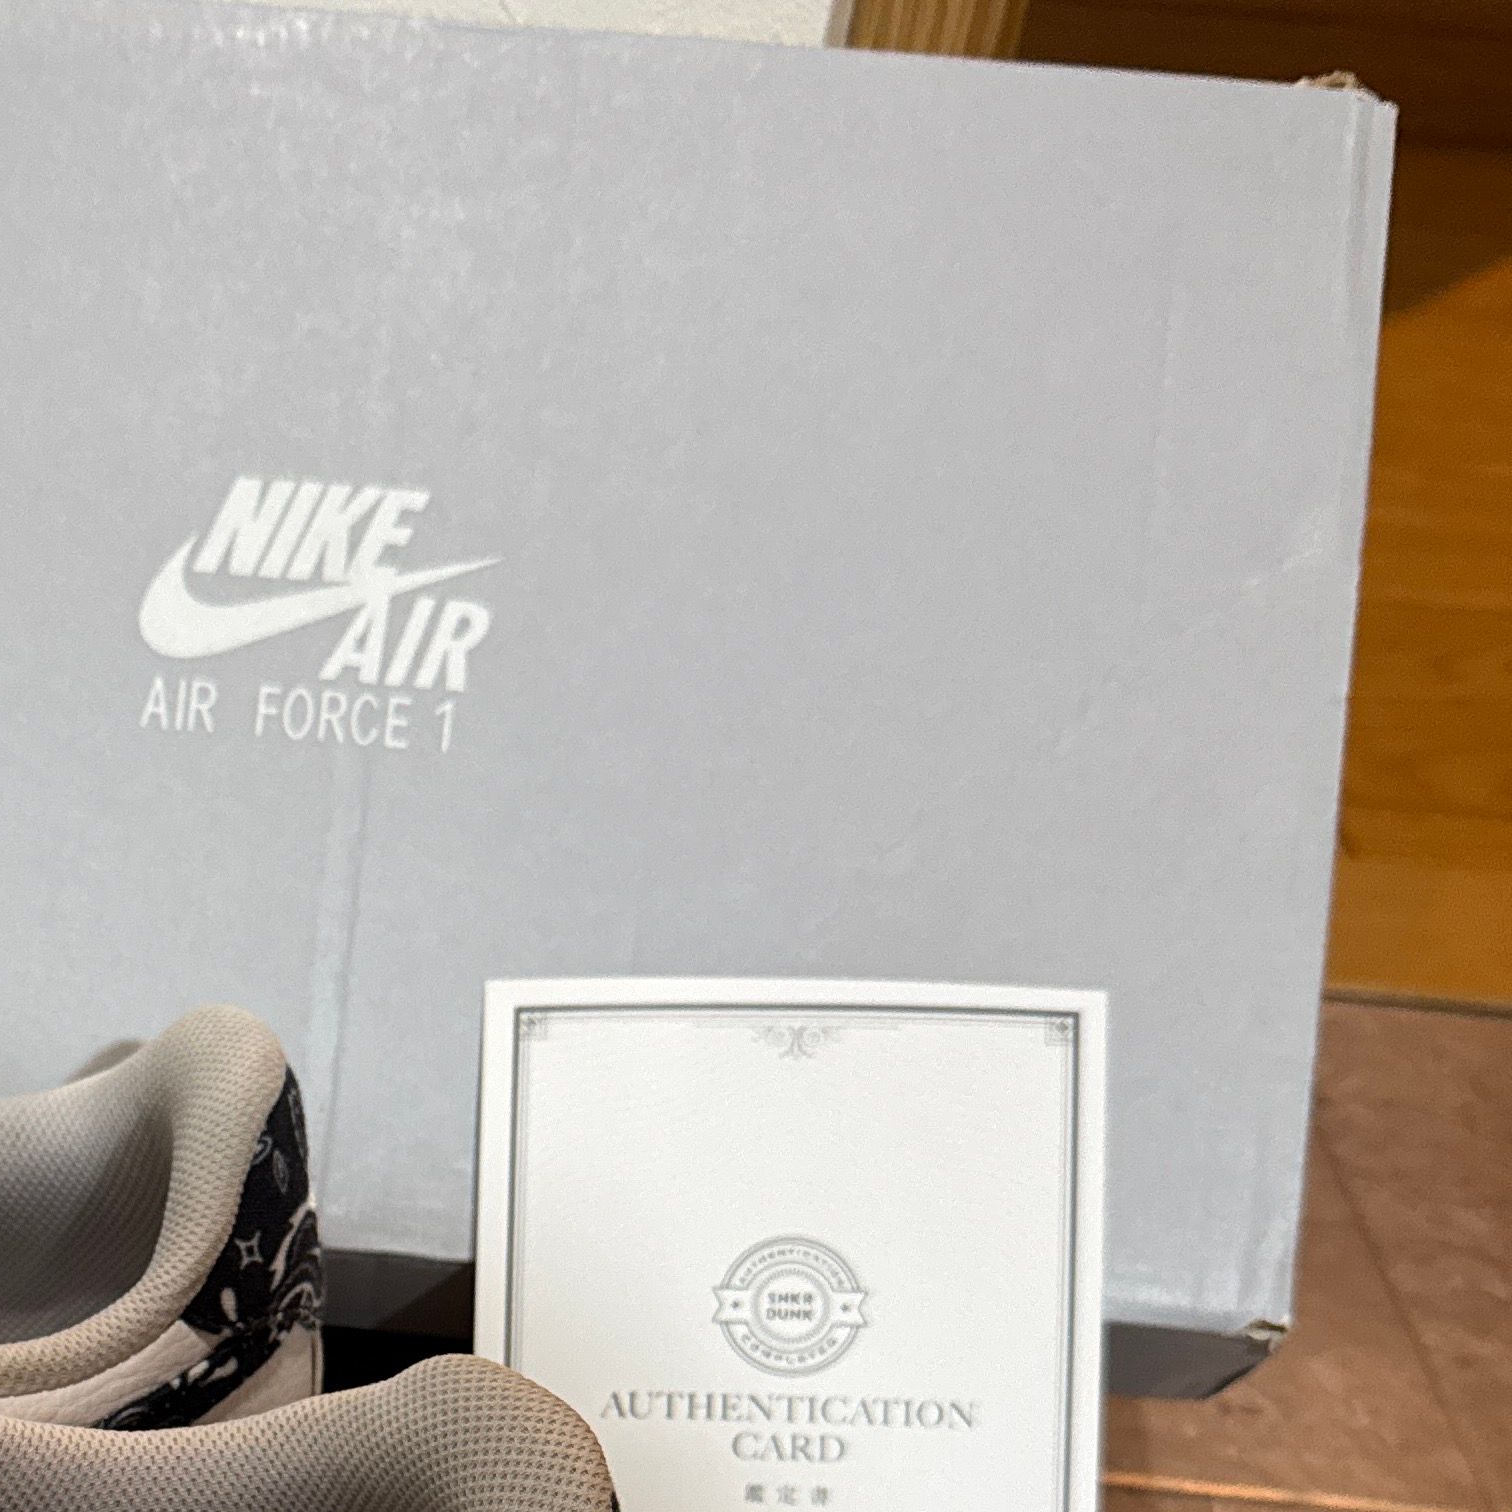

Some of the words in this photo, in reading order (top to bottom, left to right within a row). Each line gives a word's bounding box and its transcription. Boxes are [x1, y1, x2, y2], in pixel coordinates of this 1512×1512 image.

[193, 475, 431, 584] NIKE
[318, 597, 490, 692] AIR
[140, 675, 218, 733] AIR
[255, 683, 414, 751] FORCE
[434, 700, 454, 753] 1
[765, 1307, 814, 1321] DUNK
[600, 1390, 980, 1429] AUTHENTICATION
[731, 1431, 848, 1463] CARD
